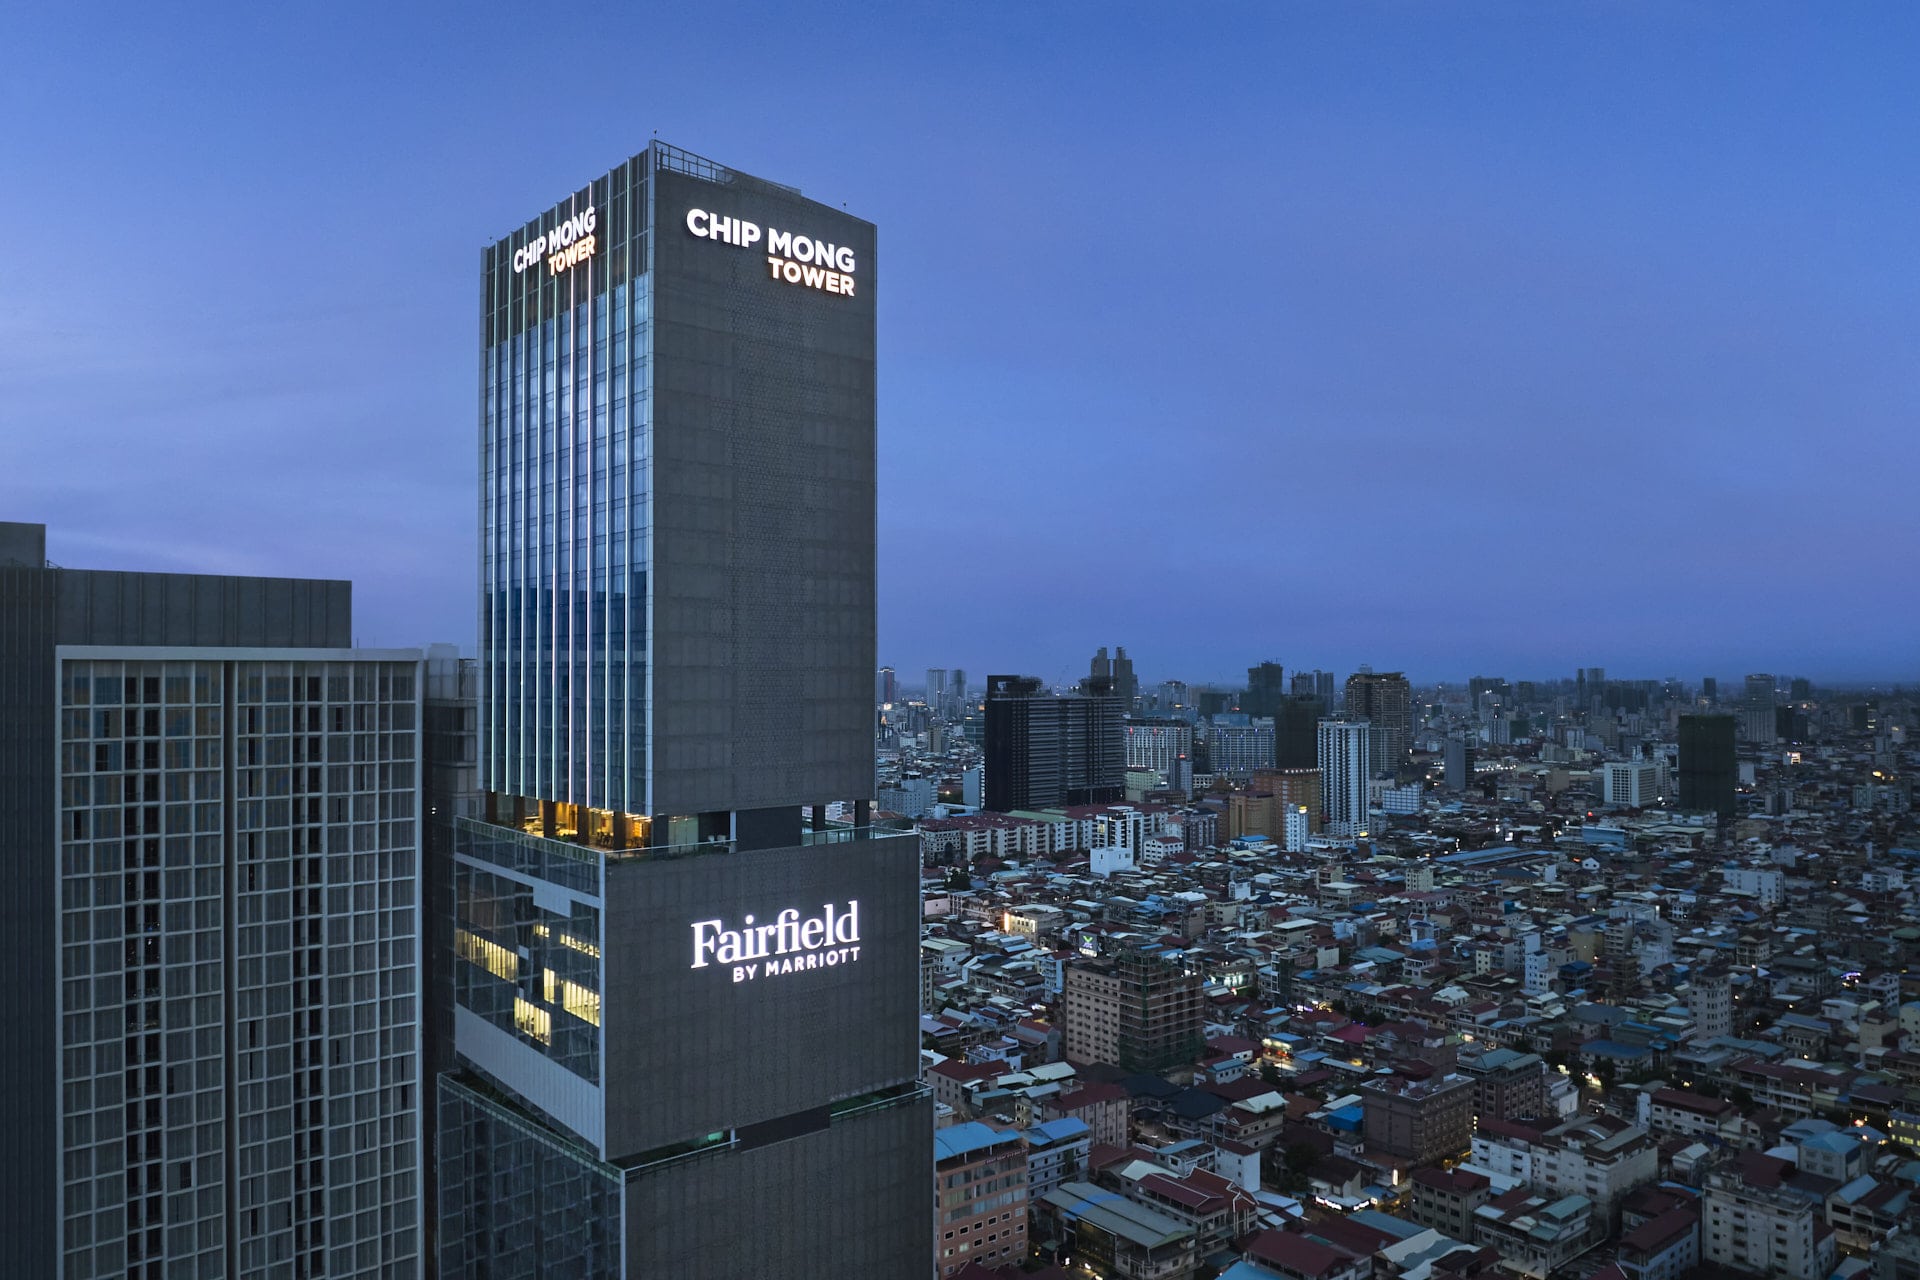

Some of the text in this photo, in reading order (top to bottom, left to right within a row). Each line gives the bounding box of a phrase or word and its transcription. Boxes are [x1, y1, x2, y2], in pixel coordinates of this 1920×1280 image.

[514, 206, 597, 274] CHIP MONG
[548, 235, 597, 277] TOWER
[686, 208, 856, 273] CHIP MONG
[767, 256, 855, 297] TOWER
[690, 900, 860, 969] Fairfield
[733, 946, 861, 983] BY MARRIOTT
